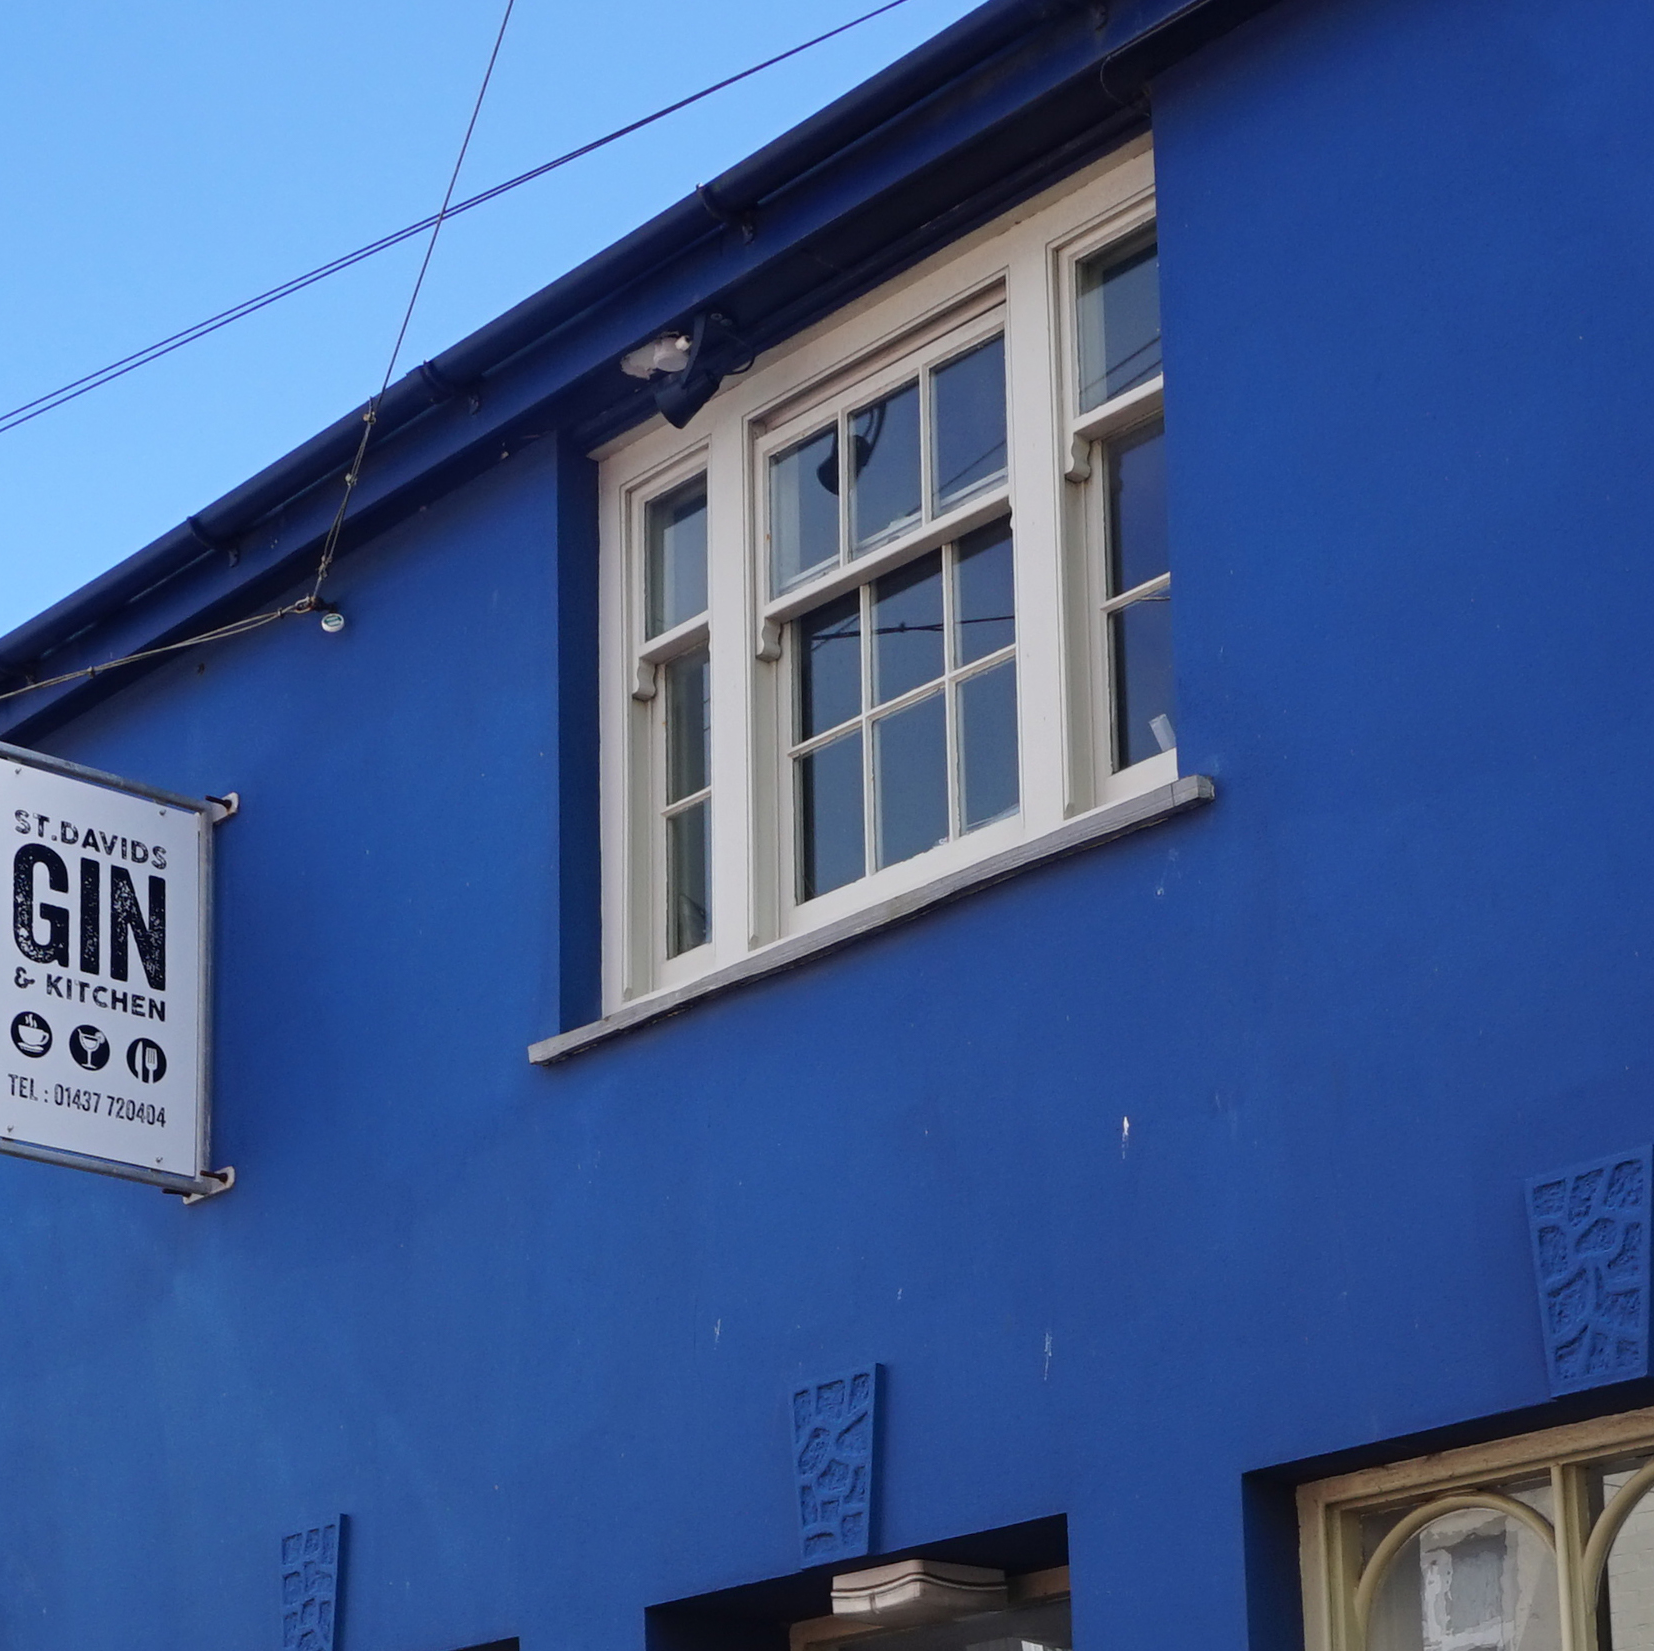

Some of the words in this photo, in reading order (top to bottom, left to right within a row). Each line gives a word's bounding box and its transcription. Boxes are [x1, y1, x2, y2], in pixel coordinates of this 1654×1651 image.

[13, 842, 166, 991] GIN
[14, 966, 35, 989] &
[46, 973, 166, 1022] KITCHEN
[54, 1083, 101, 1114] 01437
[106, 1095, 167, 1128] 720404
